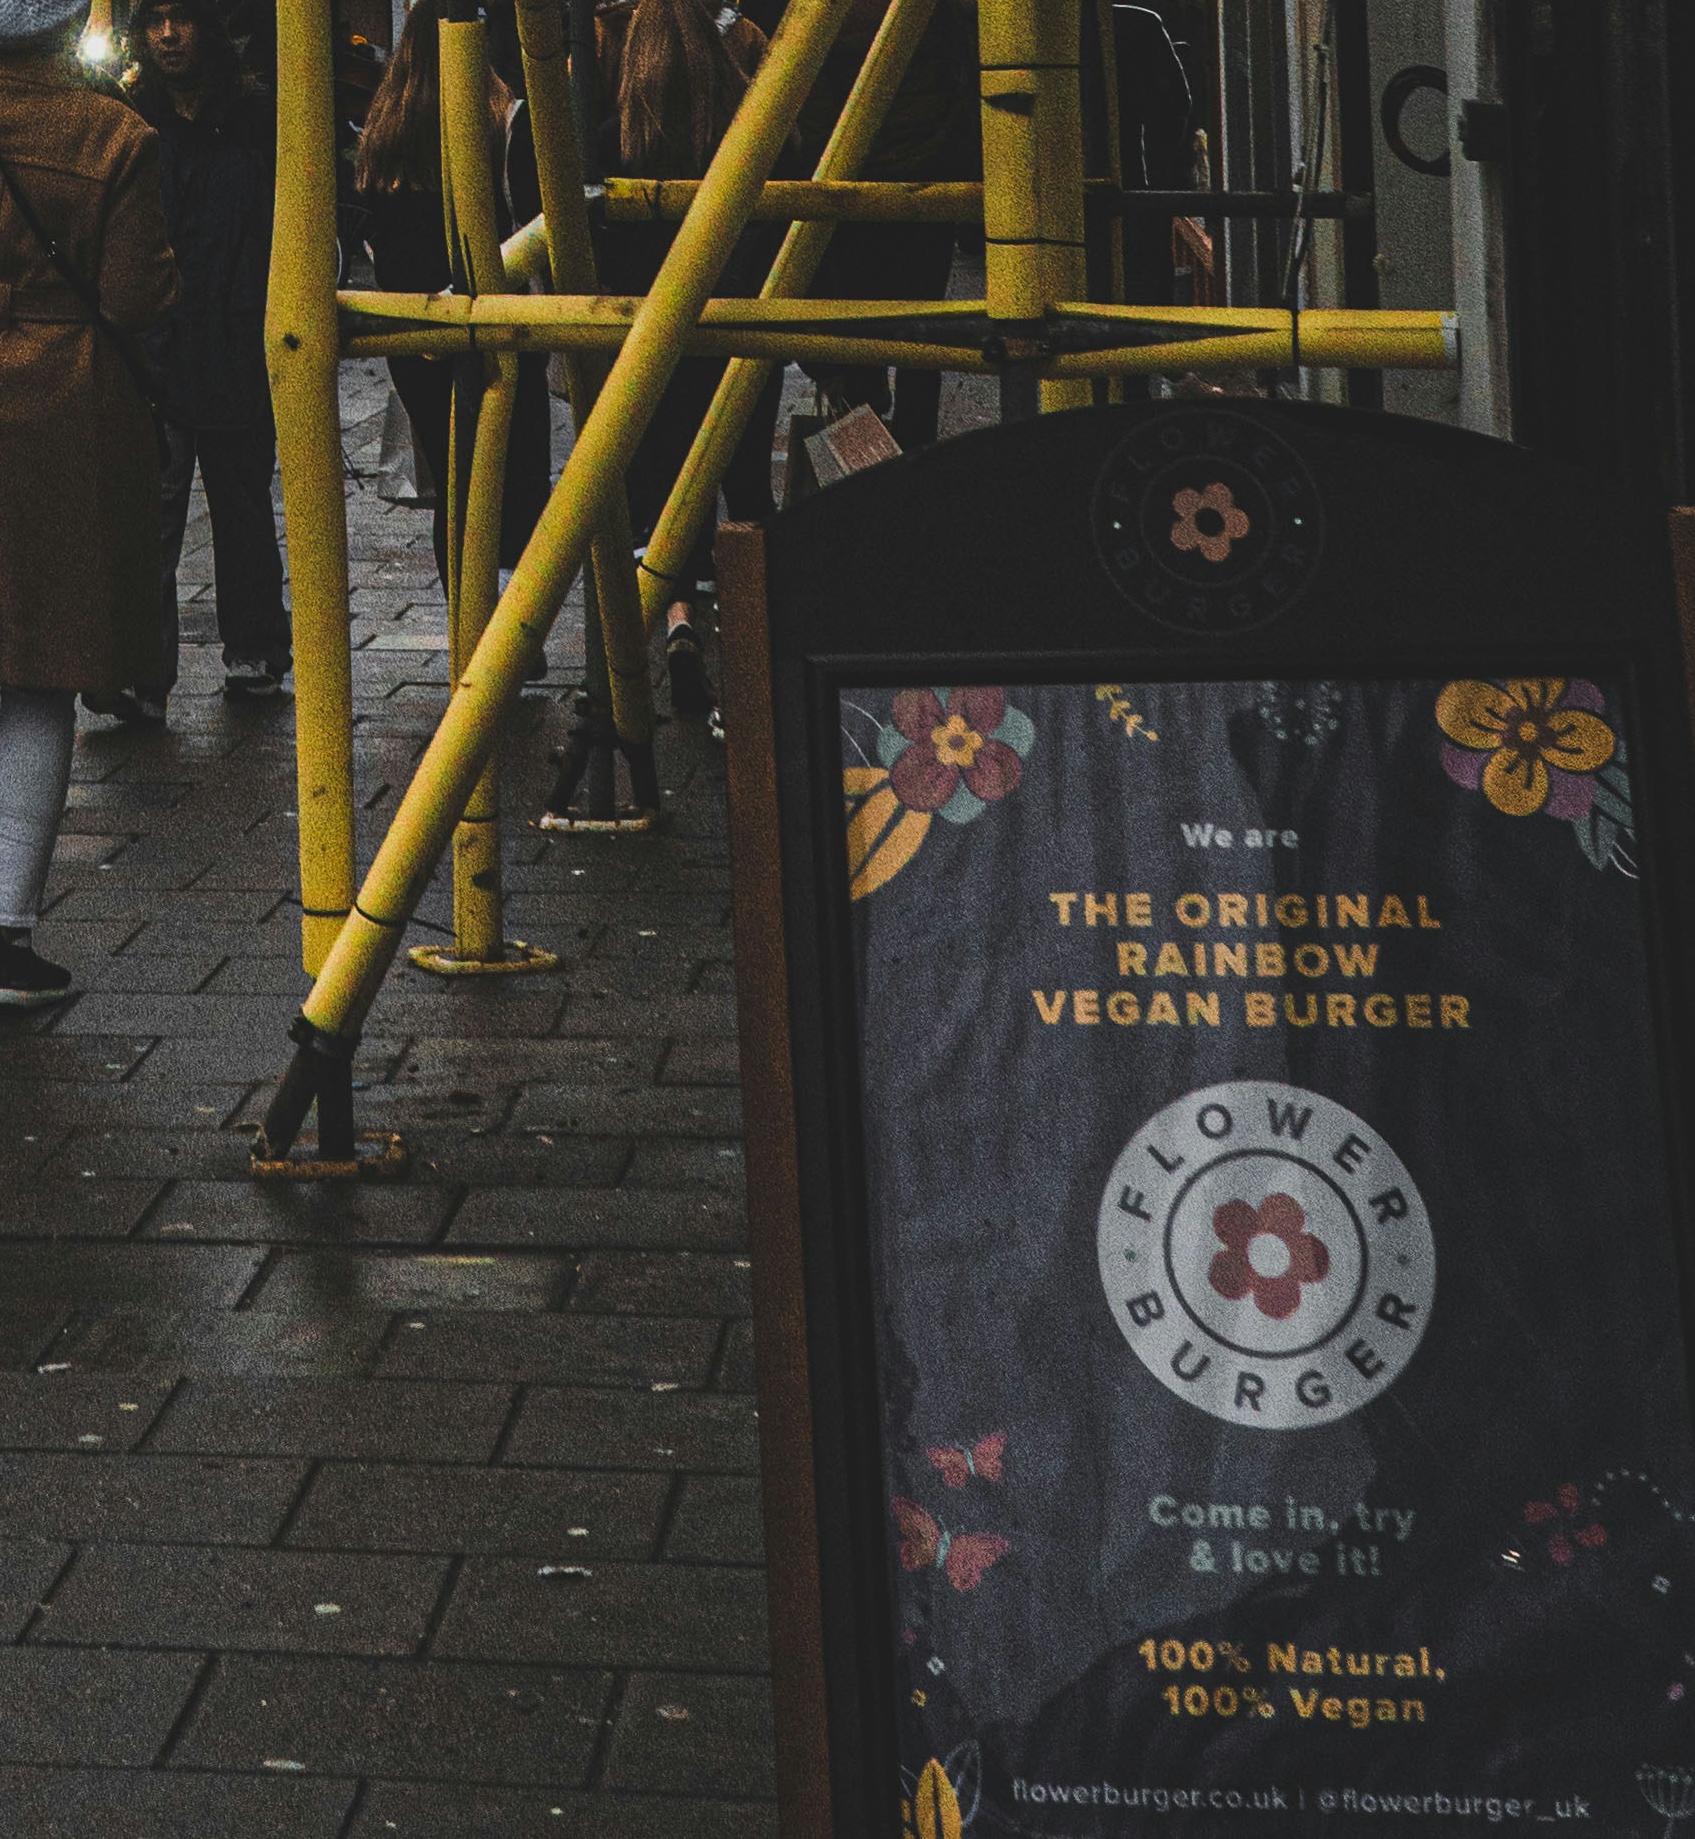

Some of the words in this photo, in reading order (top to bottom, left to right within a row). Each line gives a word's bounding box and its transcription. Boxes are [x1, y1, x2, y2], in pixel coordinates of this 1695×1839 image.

[1110, 421, 1302, 504] FLOWER
[1113, 543, 1305, 619] BURGER
[1180, 823, 1233, 849] We
[1244, 827, 1300, 850] are
[1049, 892, 1153, 927] THE
[1175, 892, 1441, 928] ORIGINAL
[1116, 942, 1379, 978] RAINBOW
[1032, 989, 1221, 1027] VEGAN
[1245, 992, 1471, 1029] BURGER
[1121, 1098, 1409, 1226] FLOWER
[1126, 1290, 1416, 1412] BURGER
[1148, 1494, 1271, 1529] Come
[1355, 1502, 1415, 1542] try
[1189, 1541, 1216, 1573] &
[1231, 1540, 1320, 1573] love
[1336, 1541, 1382, 1576] it!
[1138, 1638, 1251, 1672] 100%
[1267, 1642, 1446, 1683] Natural,
[1163, 1684, 1276, 1719] 100%
[1289, 1687, 1426, 1729] Vegan
[1011, 1777, 1288, 1813] flowerburger.co.uk
[1318, 1787, 1591, 1823] @flowerburger_uk
